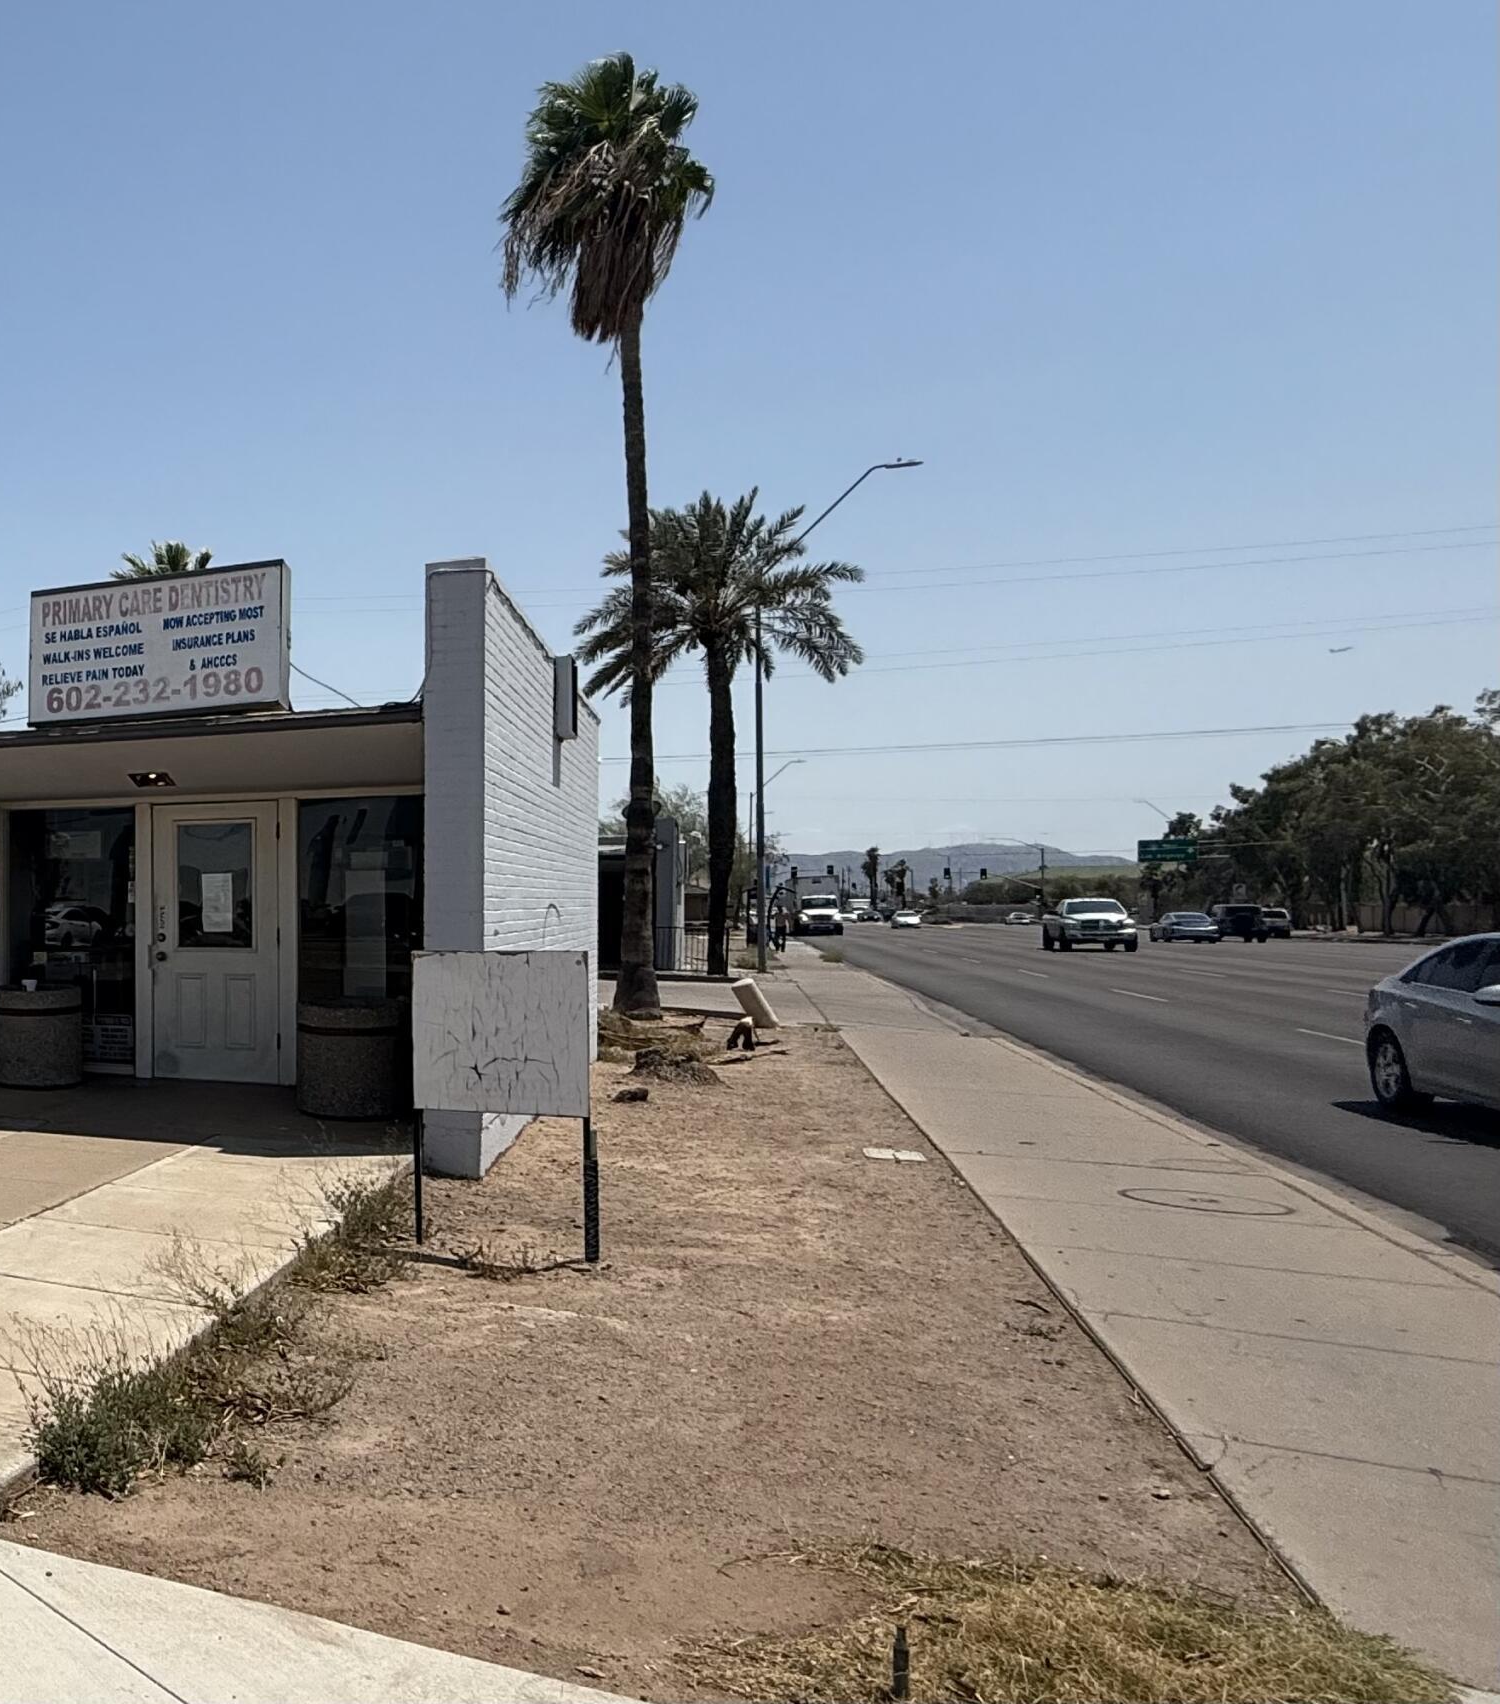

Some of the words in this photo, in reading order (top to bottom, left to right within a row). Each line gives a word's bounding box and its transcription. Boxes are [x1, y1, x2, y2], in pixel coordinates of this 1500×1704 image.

[42, 593, 114, 628] PRIMARY
[120, 587, 163, 618] CARE
[168, 573, 266, 612] DENTISTRY
[163, 616, 184, 631] NOW
[186, 609, 237, 628] ACCEPTING
[239, 605, 265, 621] MOST
[45, 632, 57, 645] SE
[60, 627, 93, 642] HABLA
[96, 620, 142, 639] ESPAÑOL
[172, 634, 223, 652] INSURANCE
[226, 629, 256, 645] PLANS
[43, 650, 91, 666] WALK-INS
[94, 643, 145, 660] WELCOME
[189, 659, 195, 671] &
[201, 654, 237, 670] AHCCCS
[41, 671, 82, 687] RELIEVE
[85, 669, 109, 682] PAIN
[111, 664, 145, 681] TODAY
[47, 666, 264, 713] 602-232-1980
